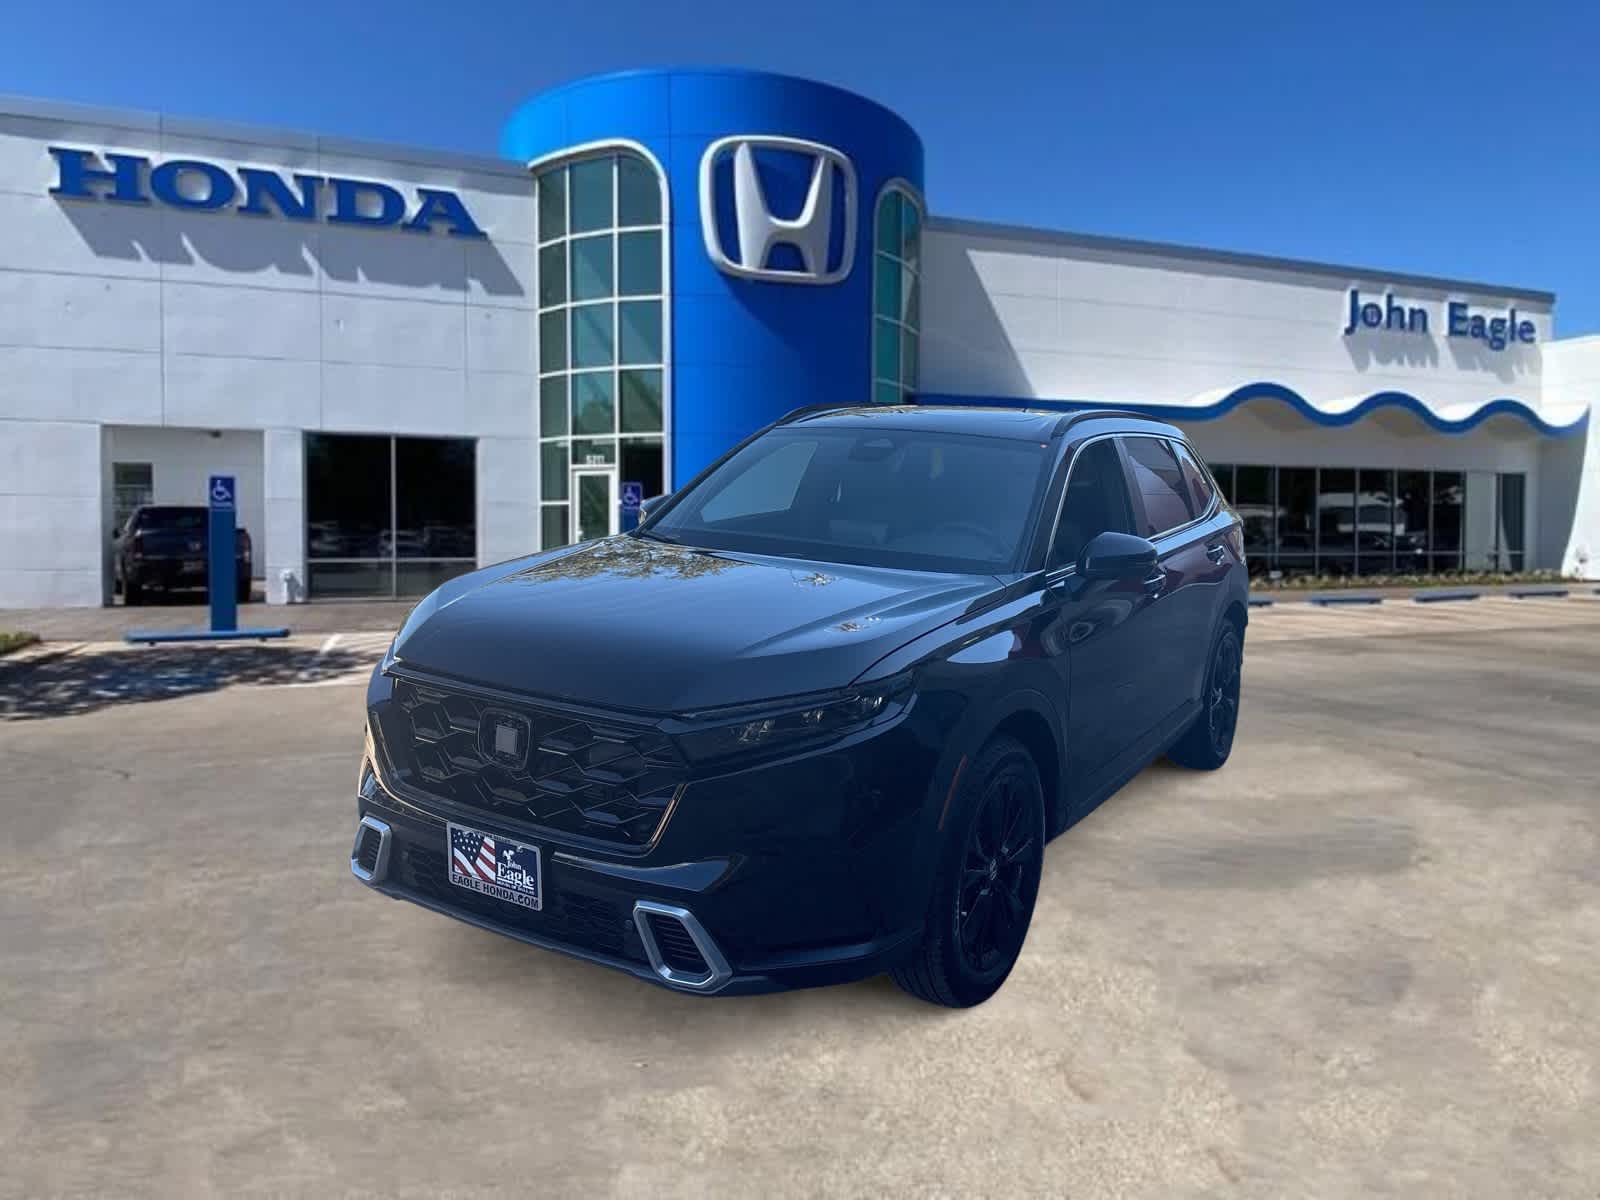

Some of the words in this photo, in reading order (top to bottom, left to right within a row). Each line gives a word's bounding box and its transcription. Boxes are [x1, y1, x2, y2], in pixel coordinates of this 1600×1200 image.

[48, 146, 488, 240] HONDA
[1344, 289, 1429, 336] John
[1447, 301, 1536, 351] Eagle
[497, 862, 535, 887] Eagle
[506, 860, 522, 871] John
[453, 872, 481, 892] EAGLE
[483, 883, 539, 909] HONDA.COM
